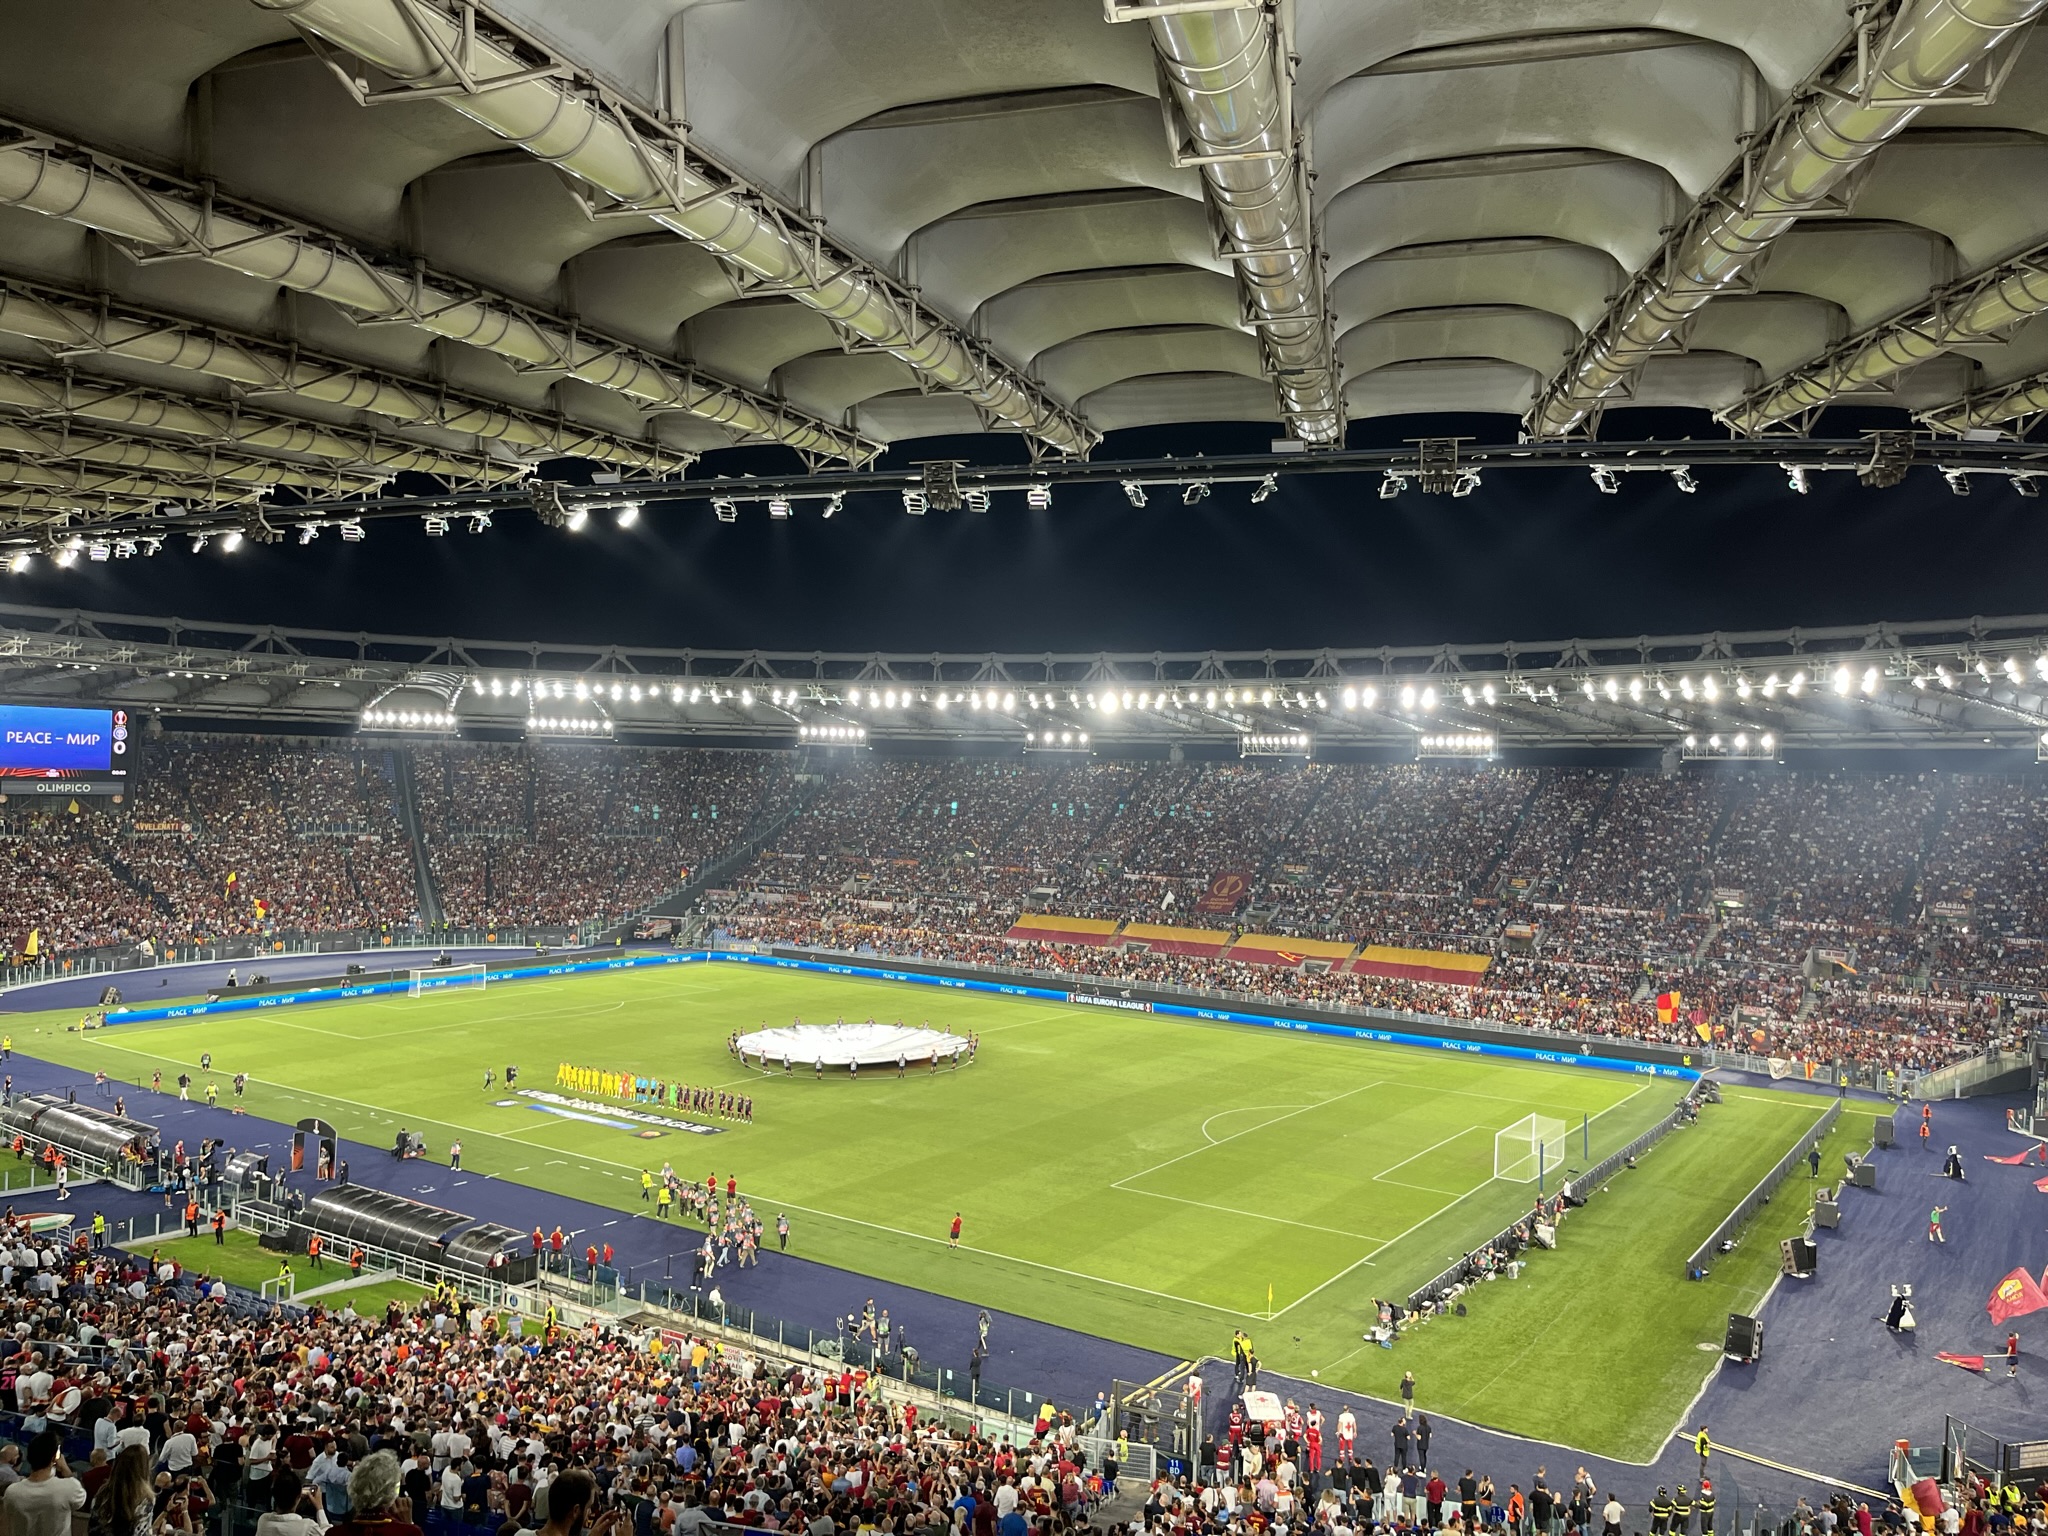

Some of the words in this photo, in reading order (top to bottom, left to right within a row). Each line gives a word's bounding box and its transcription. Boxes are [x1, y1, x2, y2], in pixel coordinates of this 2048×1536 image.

[6, 731, 52, 744] PEACE
[66, 733, 100, 746] МИР
[113, 741, 126, 754] 0
[36, 784, 91, 792] OLIMPICO
[134, 822, 178, 830] AVVELENATI
[1093, 998, 1118, 1007] EUROPA
[1119, 1000, 1144, 1010] LEAGUE
[1877, 994, 1922, 1005] COMO
[1930, 998, 1966, 1007] CASSINO
[1442, 1042, 1460, 1050] PEACE
[1536, 1053, 1555, 1061] PEACE
[1636, 1065, 1657, 1074] PEACE
[74, 1270, 84, 1278] 21
[0, 1375, 16, 1390] 21
[826, 1385, 833, 1393] 10
[1253, 1523, 1259, 1533] 5
